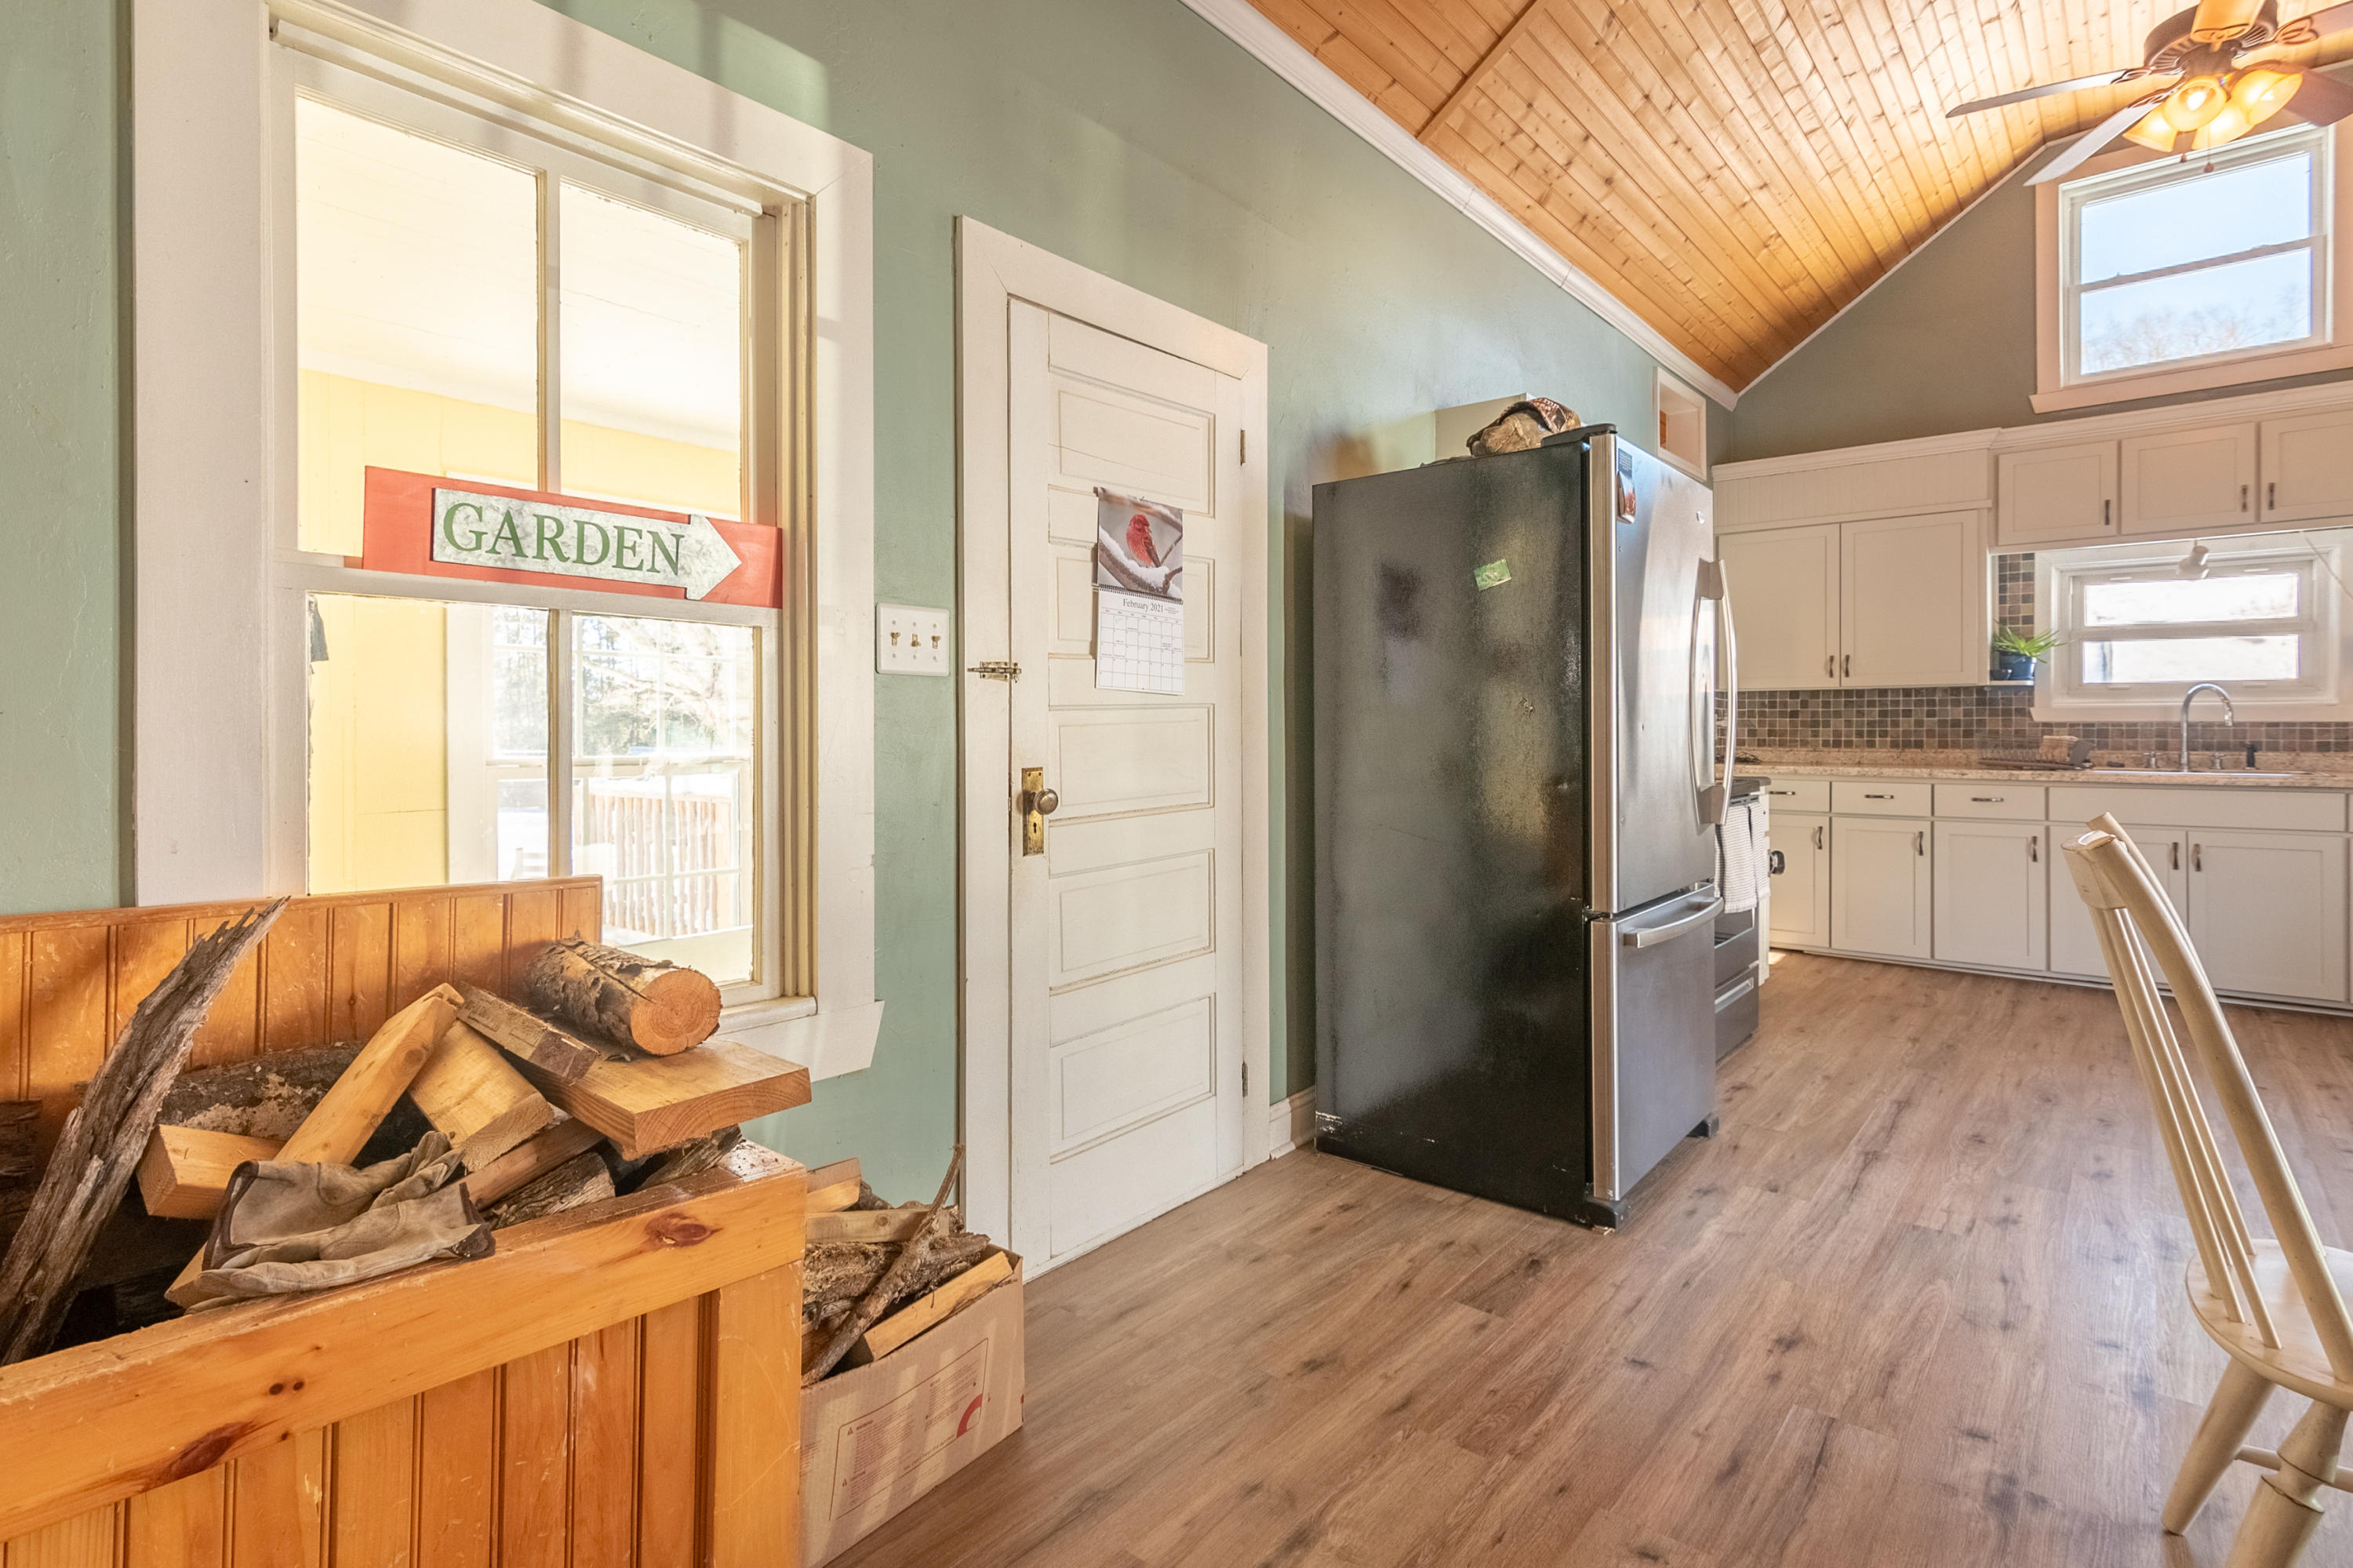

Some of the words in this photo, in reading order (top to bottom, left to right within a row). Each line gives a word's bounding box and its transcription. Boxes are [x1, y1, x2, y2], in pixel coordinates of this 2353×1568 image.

[443, 503, 684, 575] GARDEN
[1123, 598, 1149, 612] February
[1151, 603, 1164, 613] 2021
